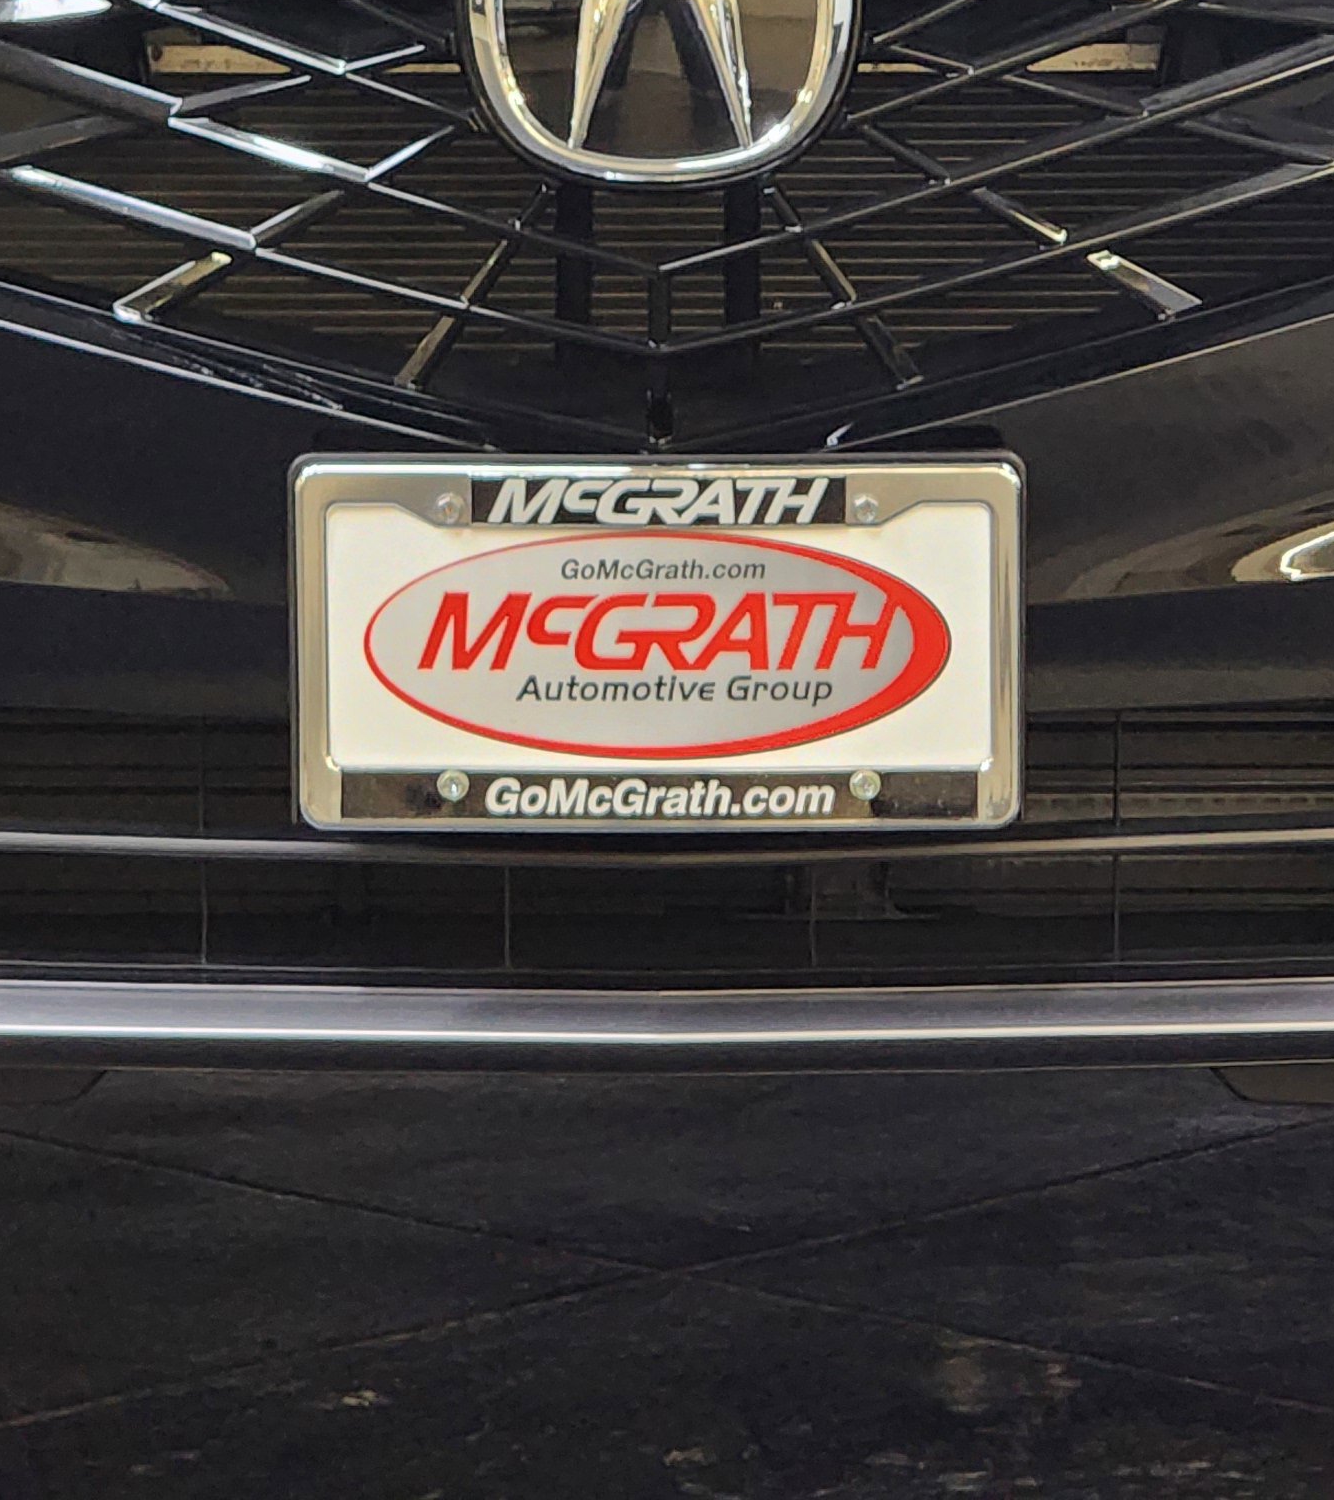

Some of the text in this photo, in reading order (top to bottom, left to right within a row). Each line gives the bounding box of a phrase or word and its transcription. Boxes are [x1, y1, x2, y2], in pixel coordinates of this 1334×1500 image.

[560, 557, 766, 581] GoMcGrath.com
[516, 675, 834, 707] Automotive Group
[485, 777, 835, 816] GoMcGrath.com
